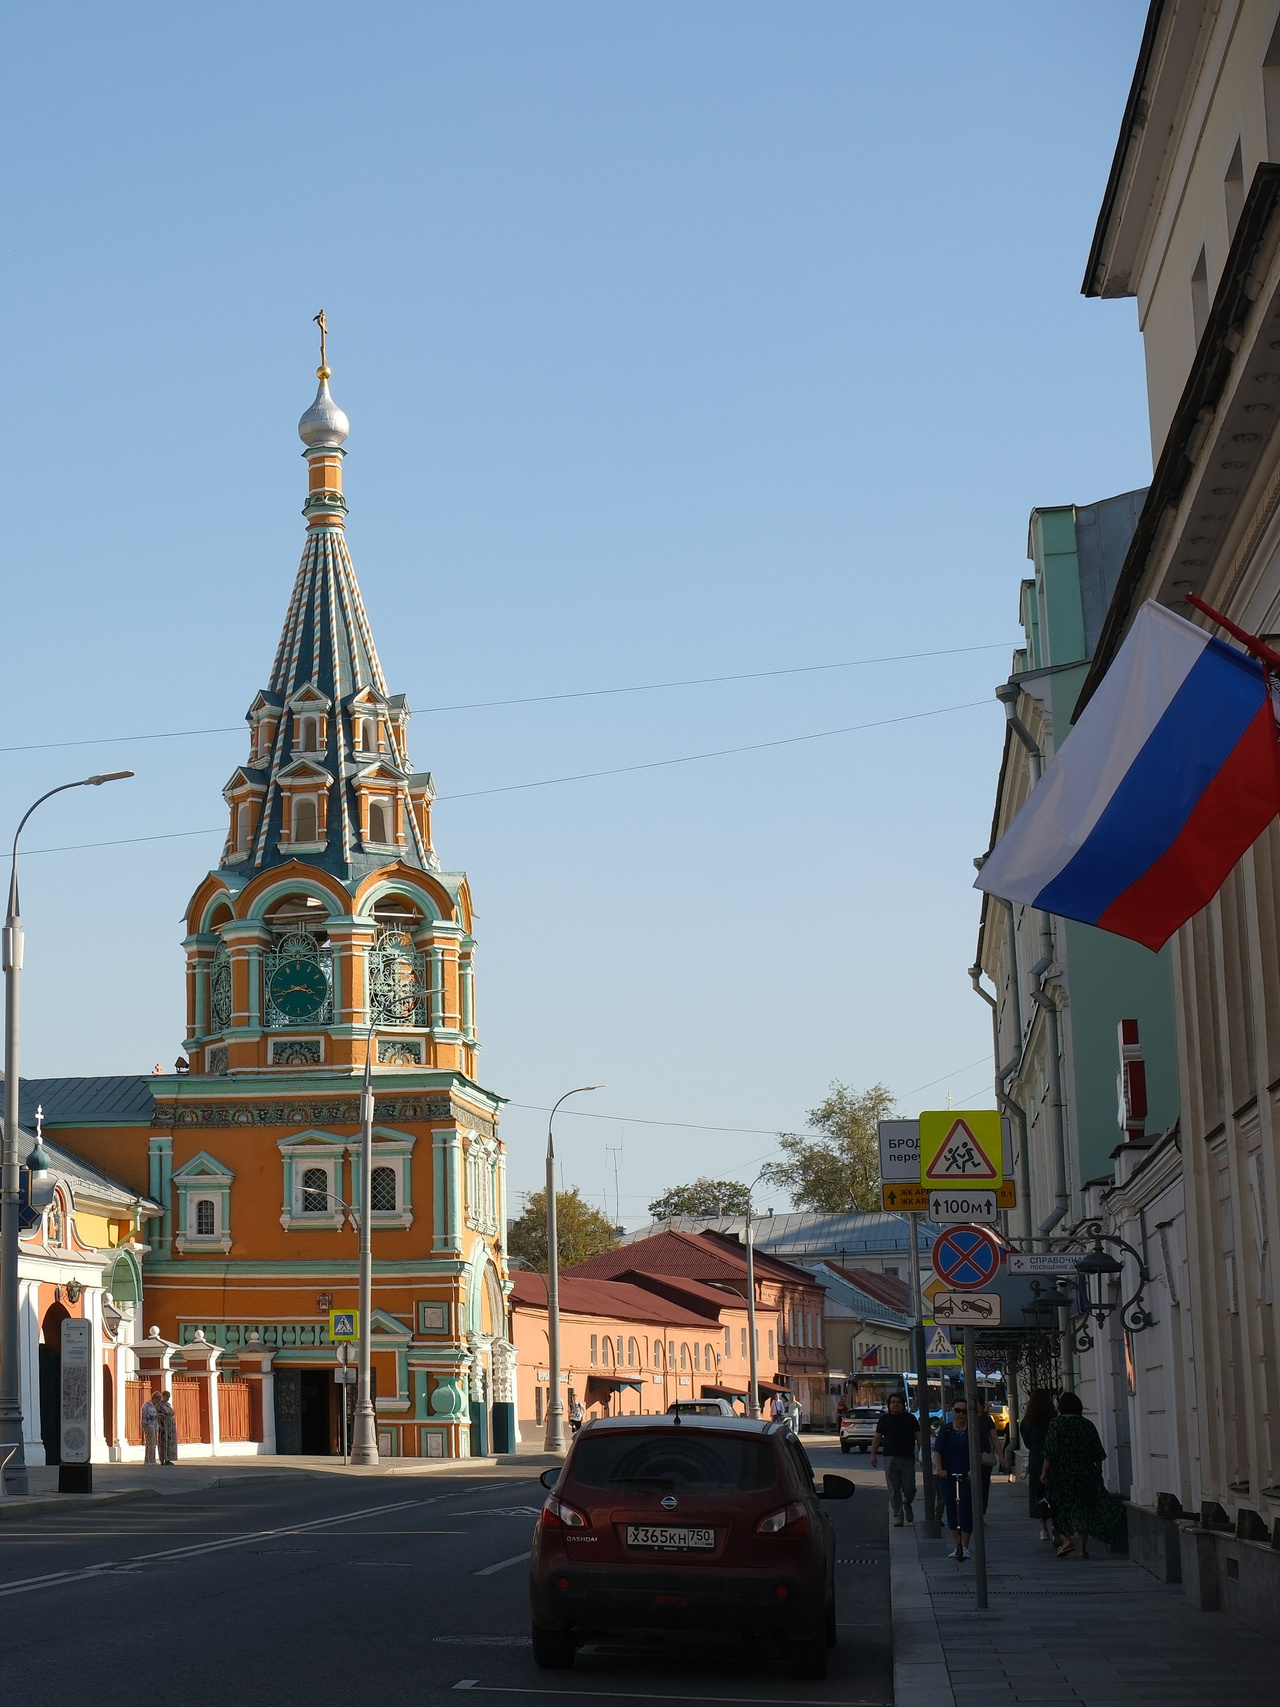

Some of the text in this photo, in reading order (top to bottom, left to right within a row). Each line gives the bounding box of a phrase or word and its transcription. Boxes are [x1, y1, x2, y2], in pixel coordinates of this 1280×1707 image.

[888, 1138, 920, 1149] БРОД
[1029, 1256, 1085, 1264] СПРАВОЧНА
[566, 1535, 598, 1543] QASHQAI
[689, 1530, 711, 1541] 750
